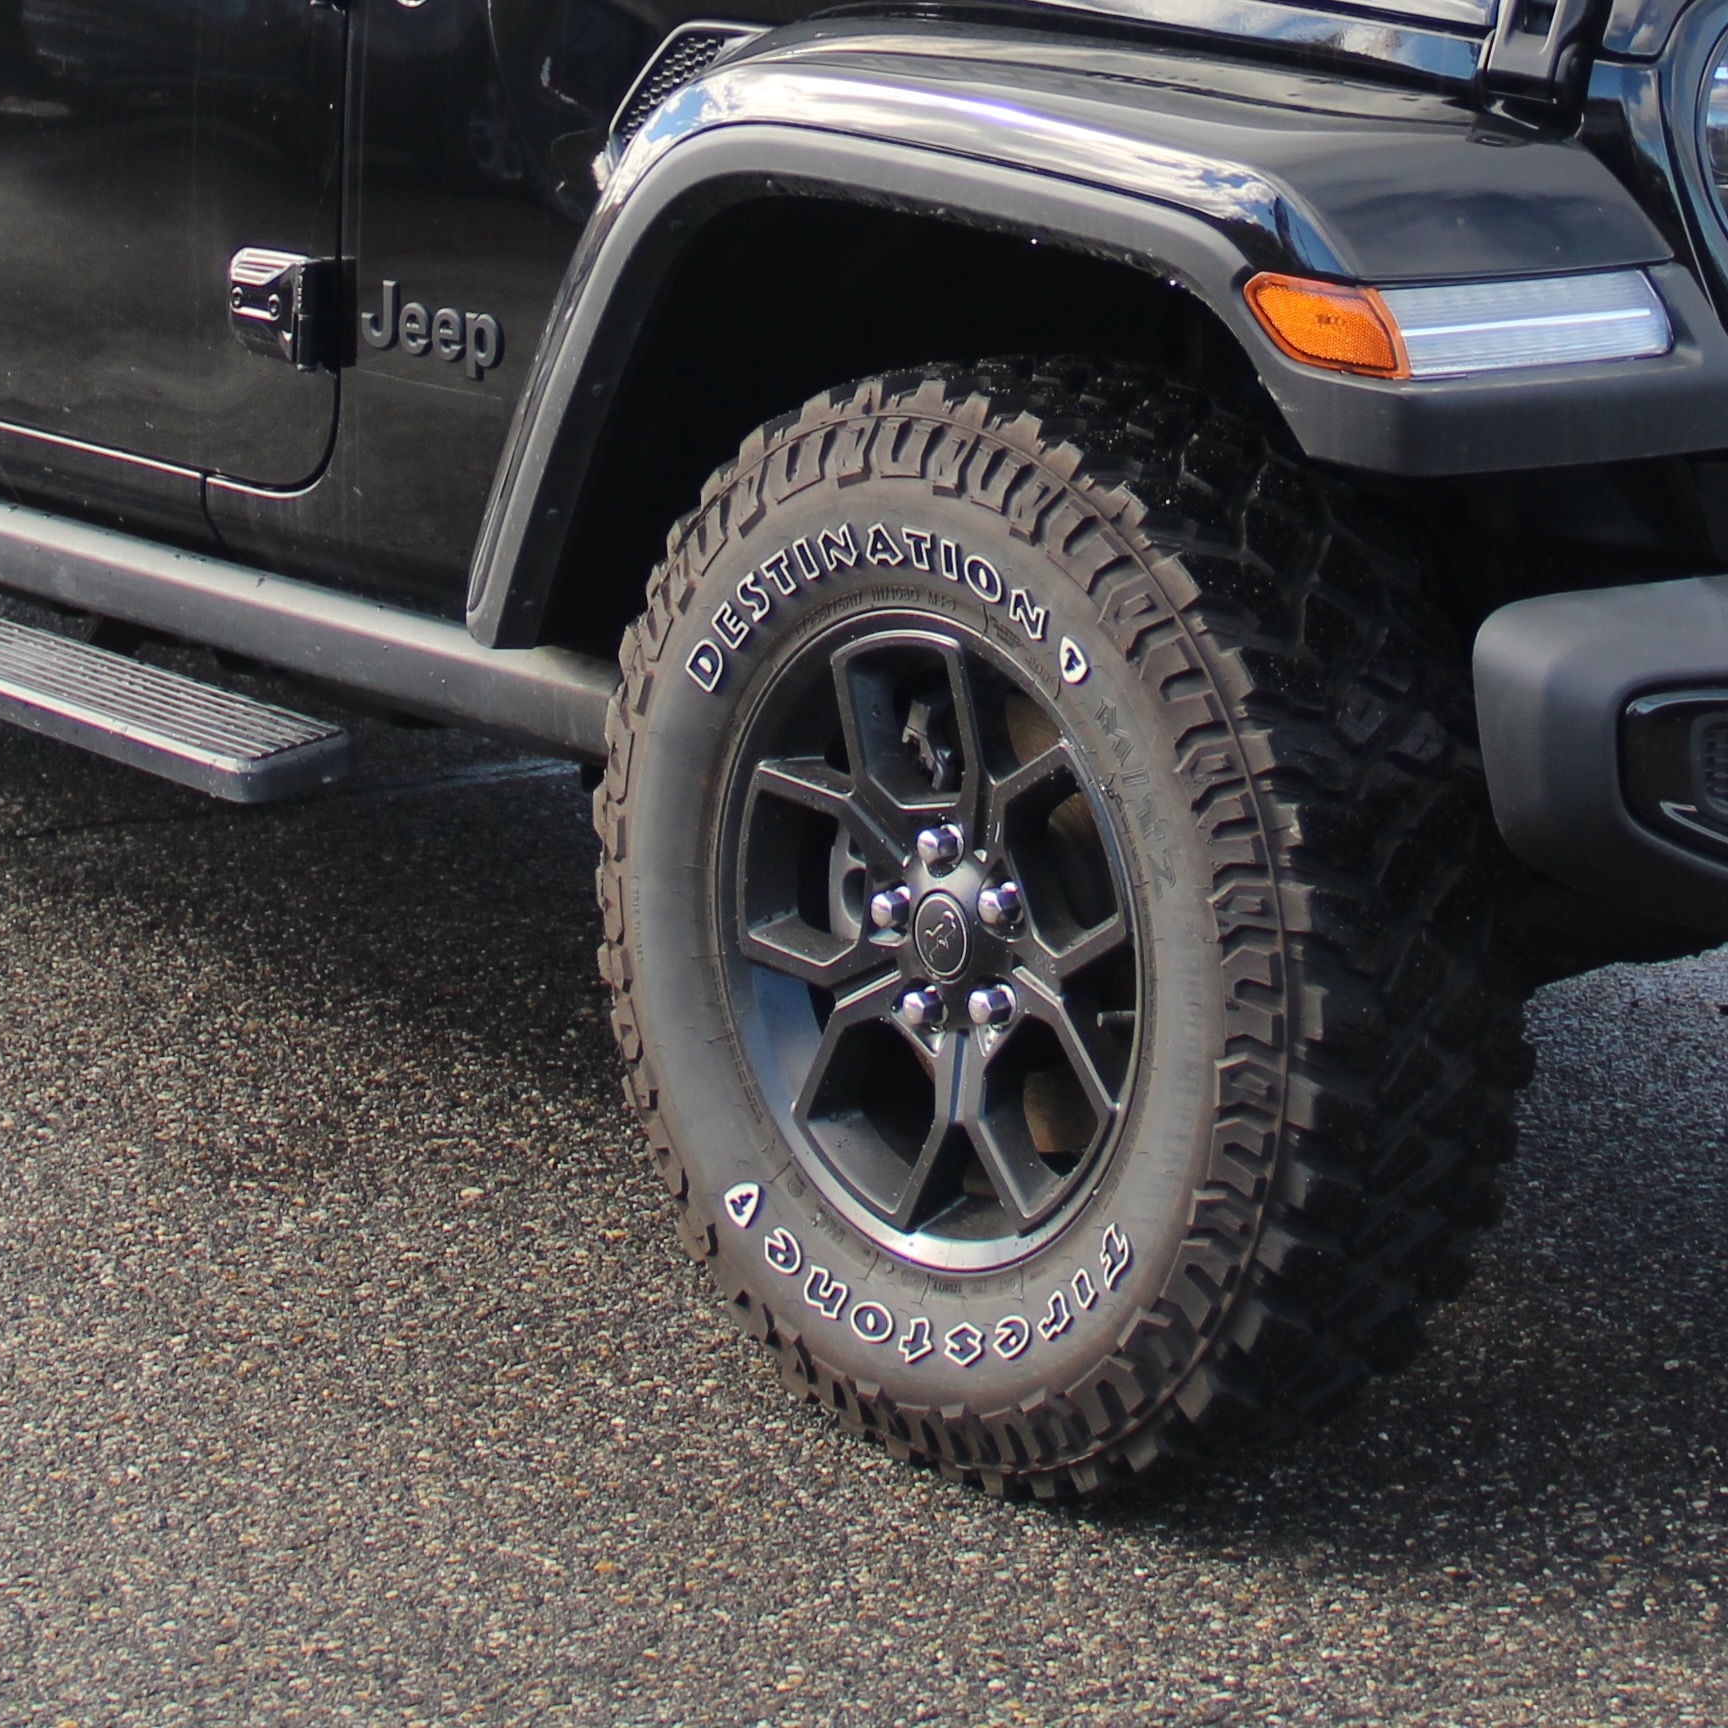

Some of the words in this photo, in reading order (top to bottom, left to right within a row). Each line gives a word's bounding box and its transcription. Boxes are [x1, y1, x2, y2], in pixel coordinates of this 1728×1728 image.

[360, 279, 503, 380] Jeep
[684, 522, 1049, 693] DESTINATION
[763, 1221, 1132, 1367] Firestone
